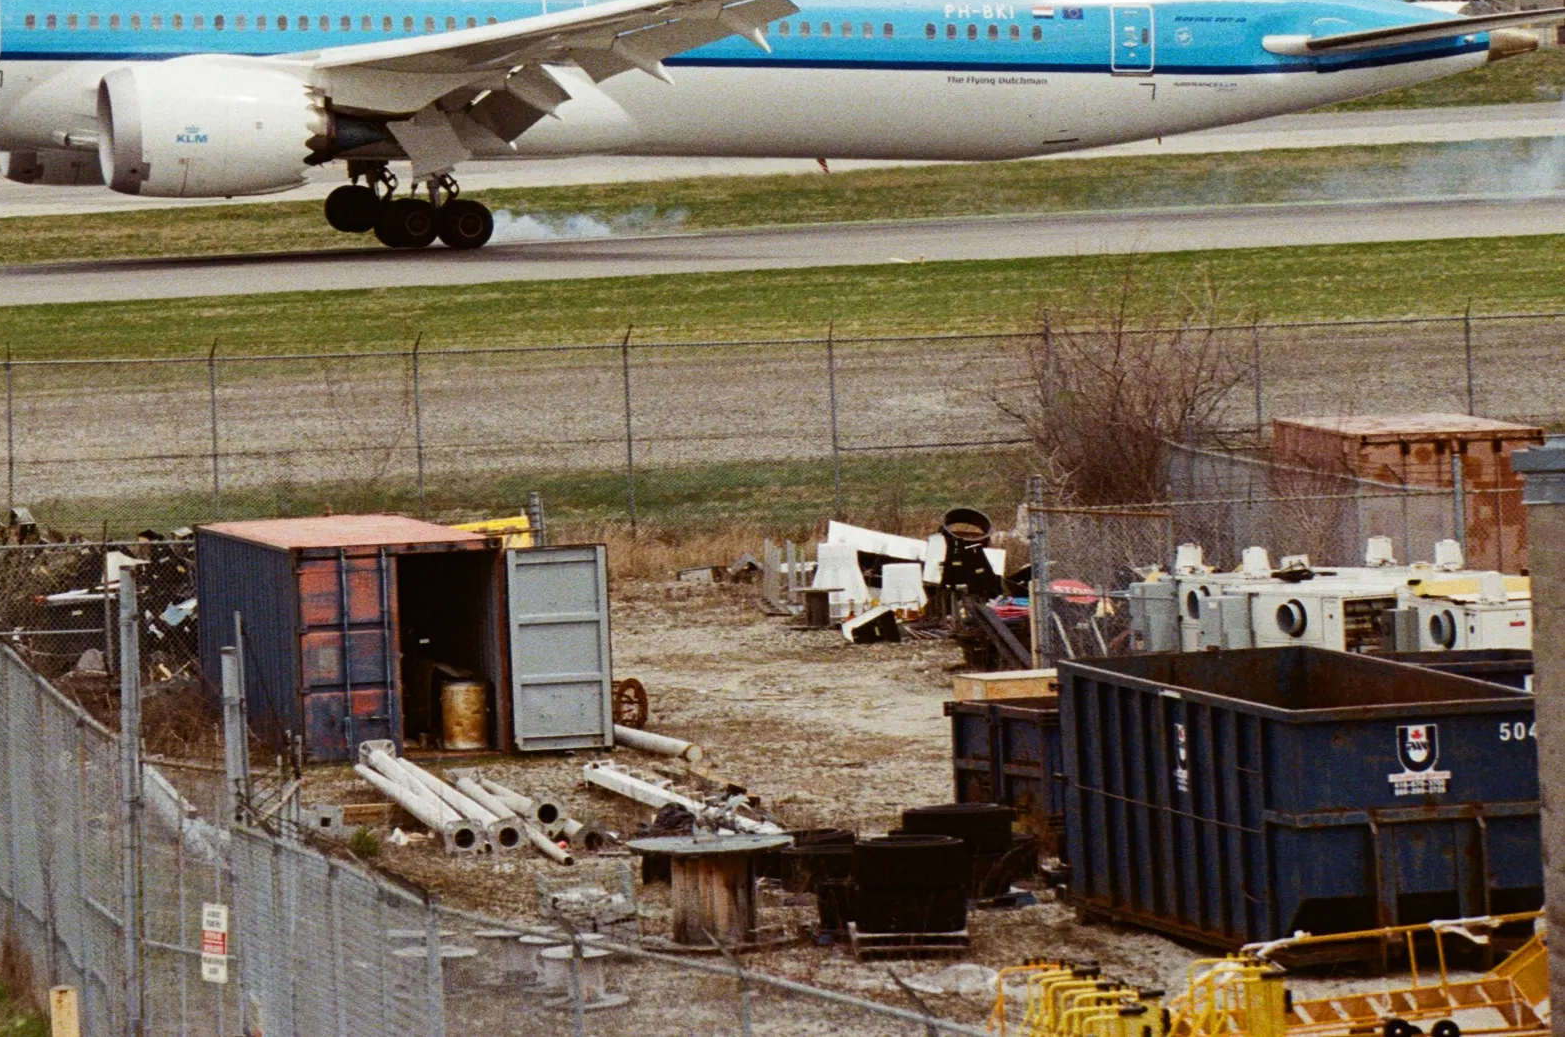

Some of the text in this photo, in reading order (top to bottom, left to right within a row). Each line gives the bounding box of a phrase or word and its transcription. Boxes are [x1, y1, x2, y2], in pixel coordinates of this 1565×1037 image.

[944, 3, 1015, 20] PH-BKI
[947, 75, 1048, 85] The Flying Dutchman
[175, 133, 208, 144] KLM
